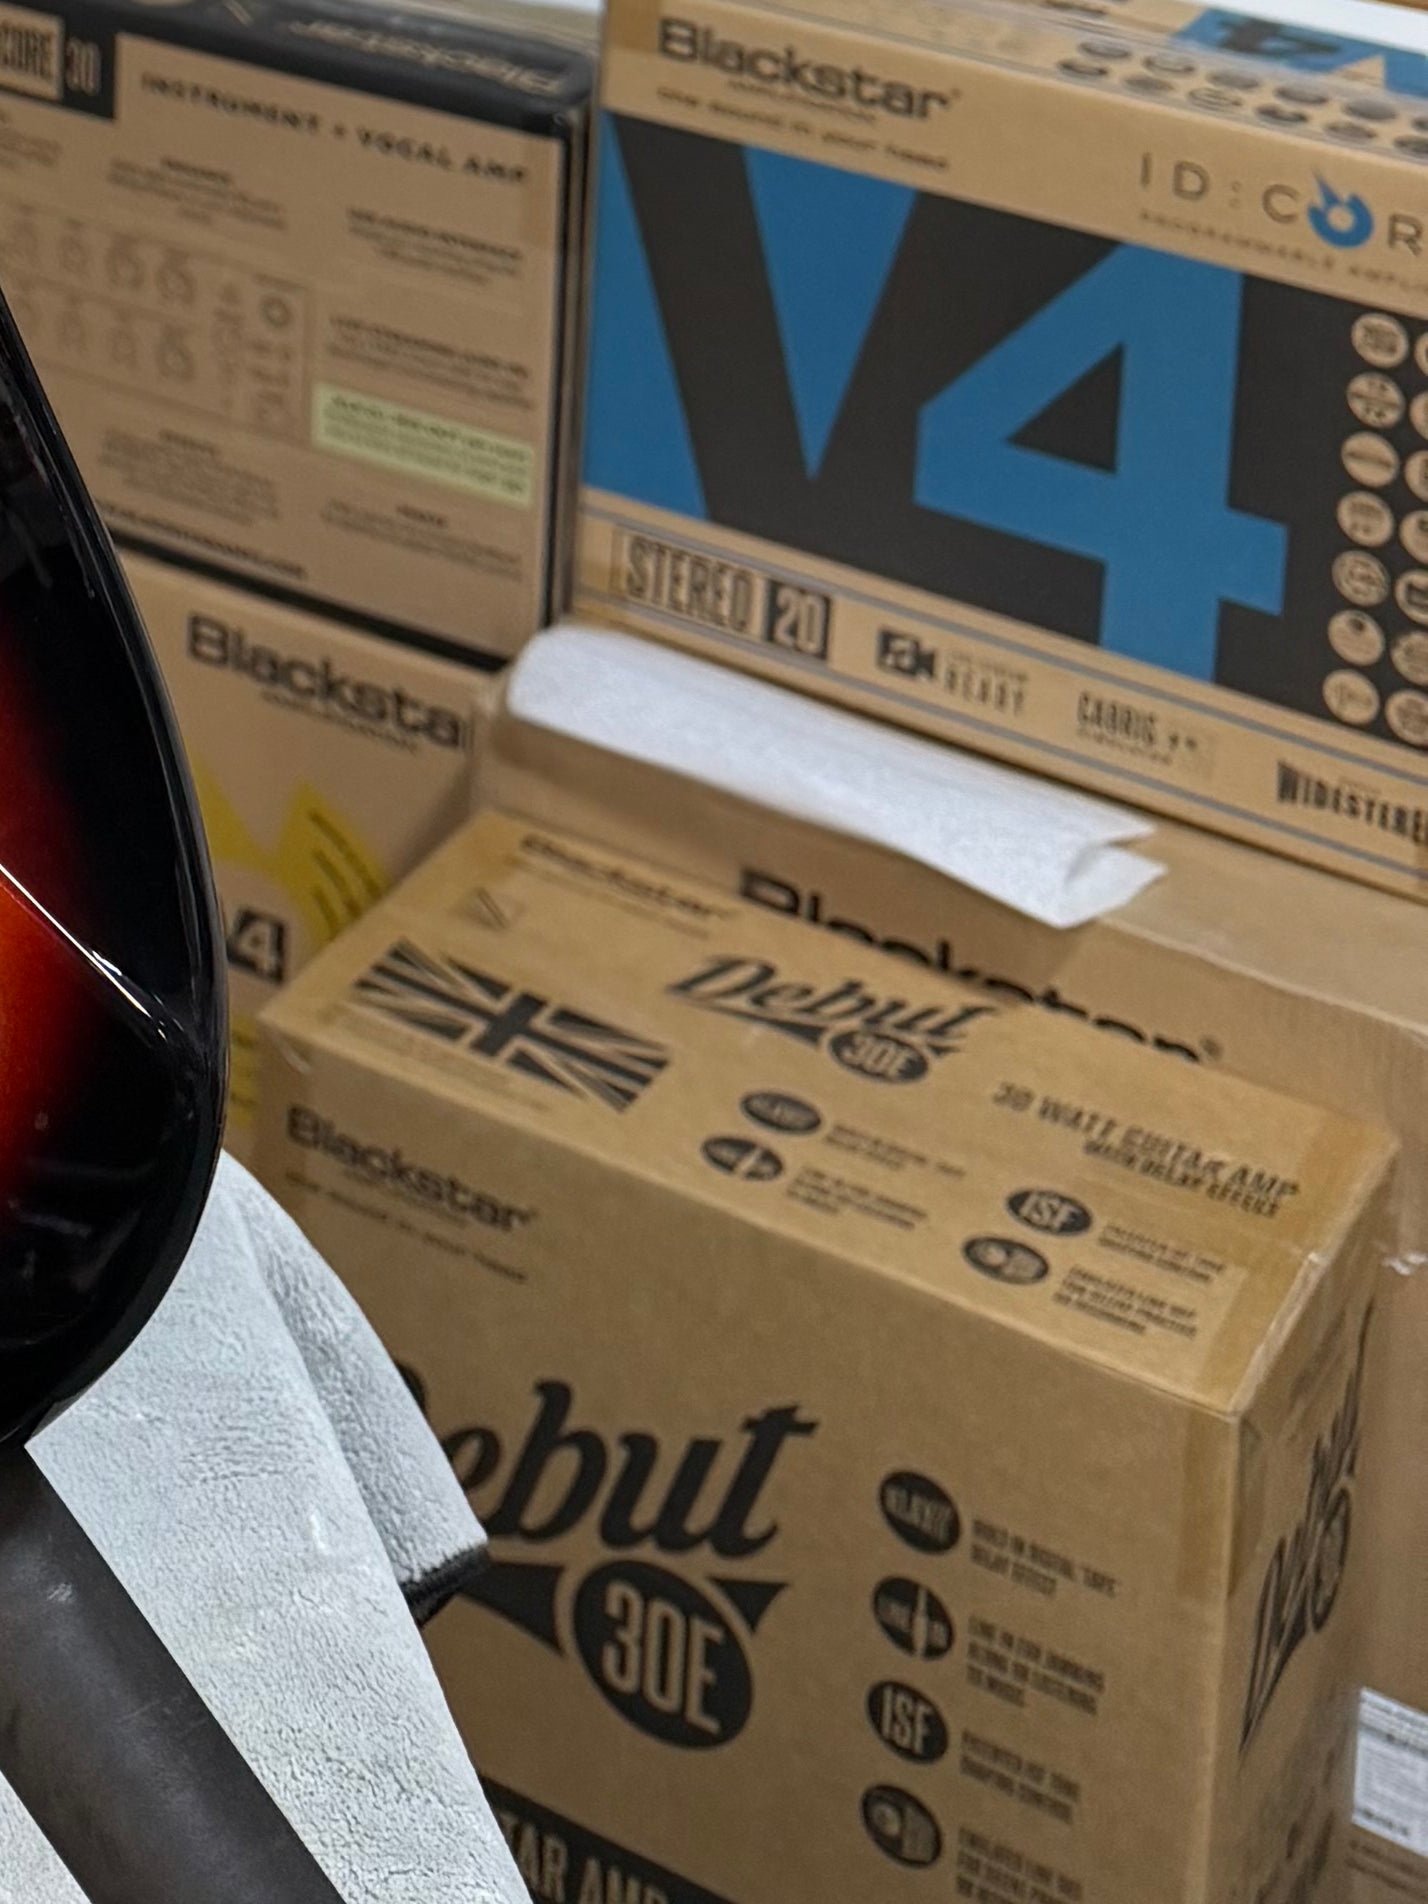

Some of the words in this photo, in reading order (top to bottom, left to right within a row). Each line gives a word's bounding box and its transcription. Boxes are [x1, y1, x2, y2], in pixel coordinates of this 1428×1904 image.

[658, 17, 951, 120] Blackstar
[142, 73, 320, 133] INSTRUMENT
[357, 126, 452, 171] VOCAL
[464, 155, 525, 183] AMP
[625, 535, 754, 633] STEREO
[773, 588, 826, 656] 20
[667, 954, 1006, 1040] Debut
[286, 1103, 534, 1233] Blackstar
[1019, 1192, 1077, 1233] ISF
[396, 1360, 820, 1559] ebut
[601, 1580, 722, 1735] 30E
[881, 1684, 932, 1757] ISF
